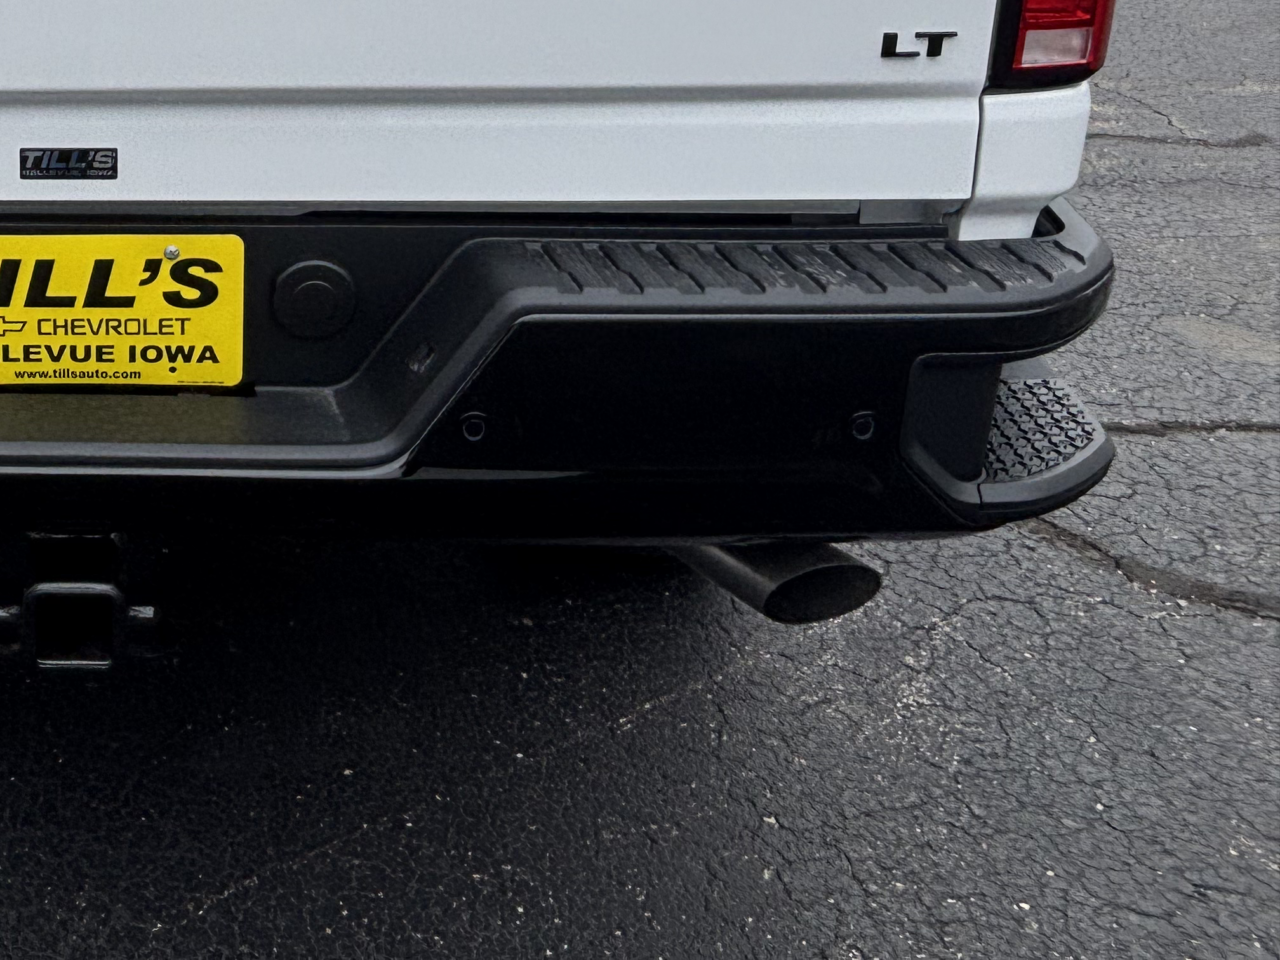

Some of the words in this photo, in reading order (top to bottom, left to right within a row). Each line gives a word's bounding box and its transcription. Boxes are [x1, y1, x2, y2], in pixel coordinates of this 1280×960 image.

[880, 31, 958, 58] LT
[21, 150, 116, 168] TILL'S
[36, 317, 191, 336] CHEVROLET
[128, 344, 220, 364] IOWA
[14, 368, 141, 380] www.tillsauto.com
